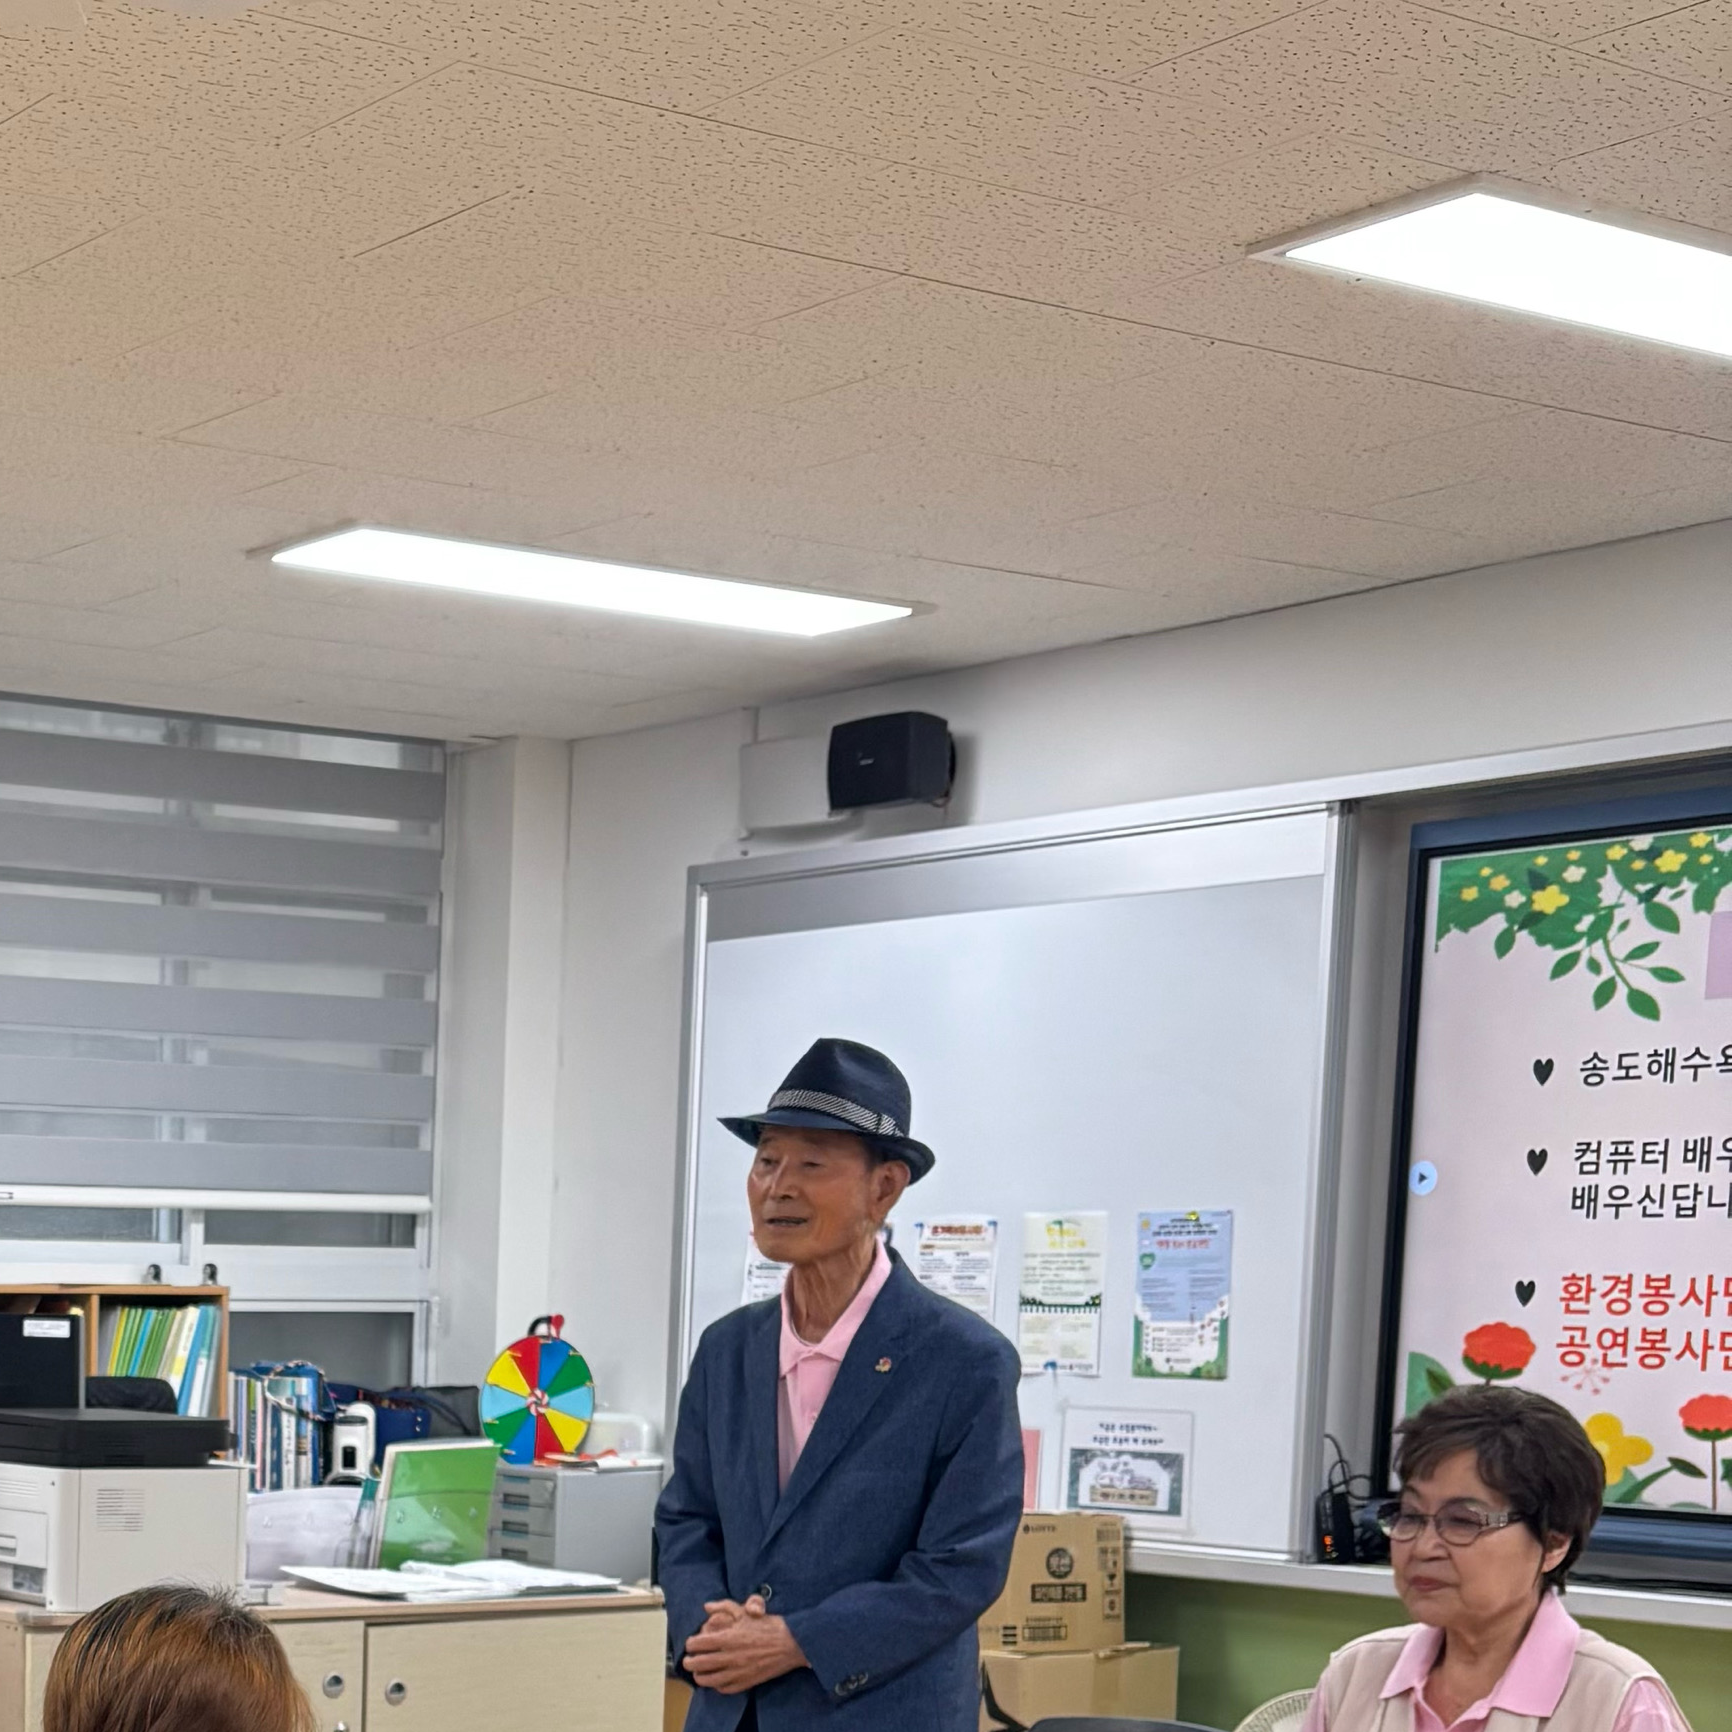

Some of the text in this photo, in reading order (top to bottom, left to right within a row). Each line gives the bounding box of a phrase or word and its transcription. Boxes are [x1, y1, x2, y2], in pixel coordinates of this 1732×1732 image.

[1574, 1138, 1669, 1176] 컴퓨터
[1571, 1182, 1732, 1220] 배우신답니
[1559, 1272, 1732, 1317] 환경봉사
